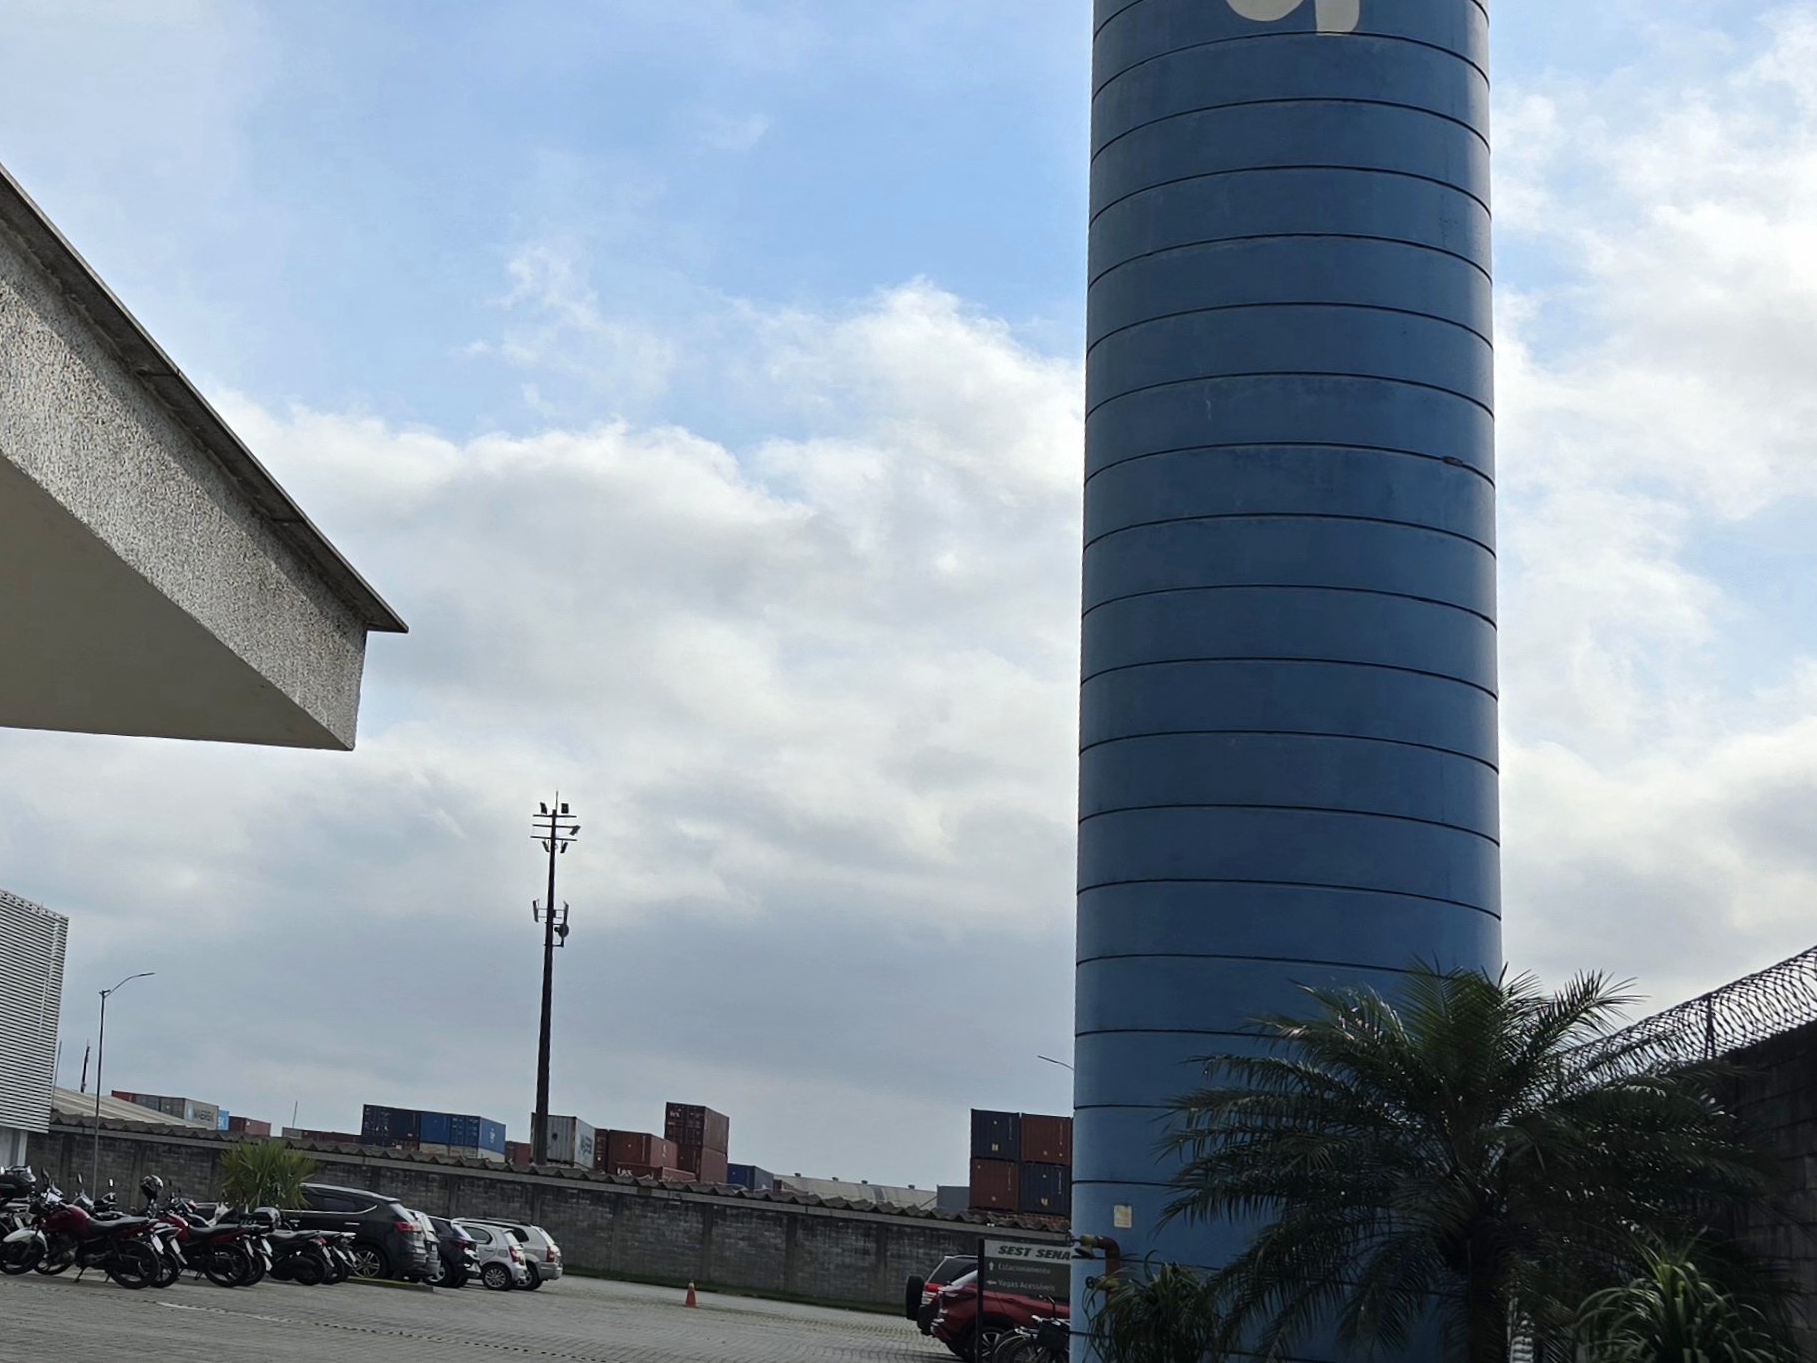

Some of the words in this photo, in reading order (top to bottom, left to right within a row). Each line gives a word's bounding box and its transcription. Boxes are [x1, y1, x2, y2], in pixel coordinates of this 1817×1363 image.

[998, 1245, 1032, 1257] SEST
[1035, 1248, 1071, 1260] SENA
[998, 1262, 1051, 1274] Estacionamento
[998, 1279, 1019, 1289] Vagas
